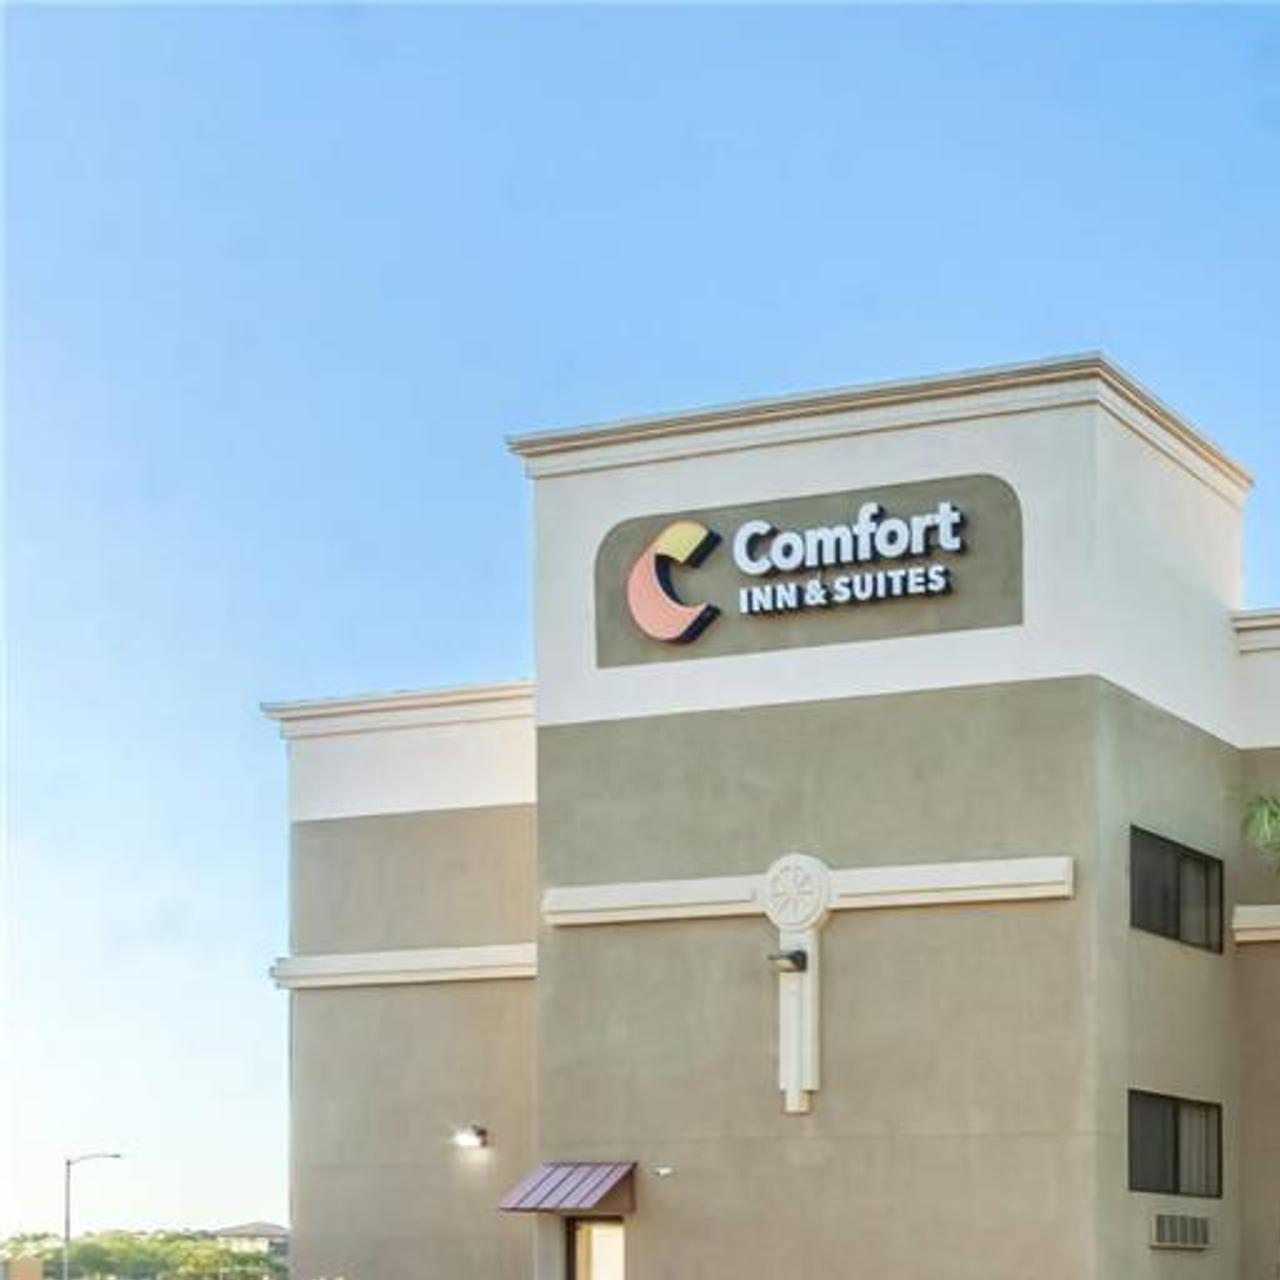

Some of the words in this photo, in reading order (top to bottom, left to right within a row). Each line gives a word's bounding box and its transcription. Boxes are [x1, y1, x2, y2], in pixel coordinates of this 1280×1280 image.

[732, 502, 963, 576] Comfort
[739, 582, 799, 614] INN
[804, 577, 831, 607] &
[832, 565, 948, 601] SUITES
